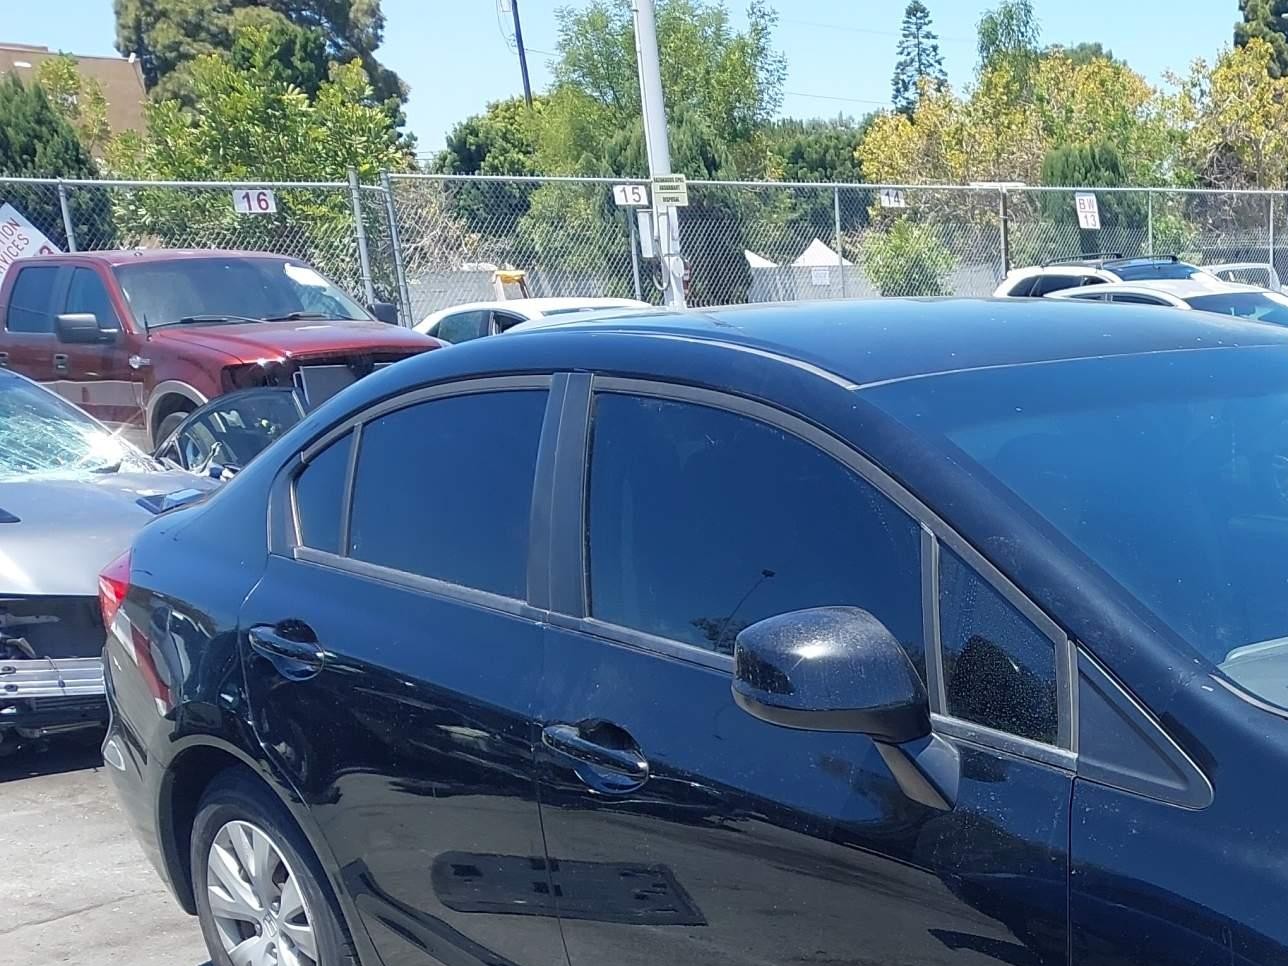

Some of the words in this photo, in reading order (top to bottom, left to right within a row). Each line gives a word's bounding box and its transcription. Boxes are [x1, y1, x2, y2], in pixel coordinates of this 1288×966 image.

[242, 191, 269, 211] 16
[620, 187, 641, 203] 15
[885, 190, 900, 205] 14
[1084, 214, 1097, 227] 13
